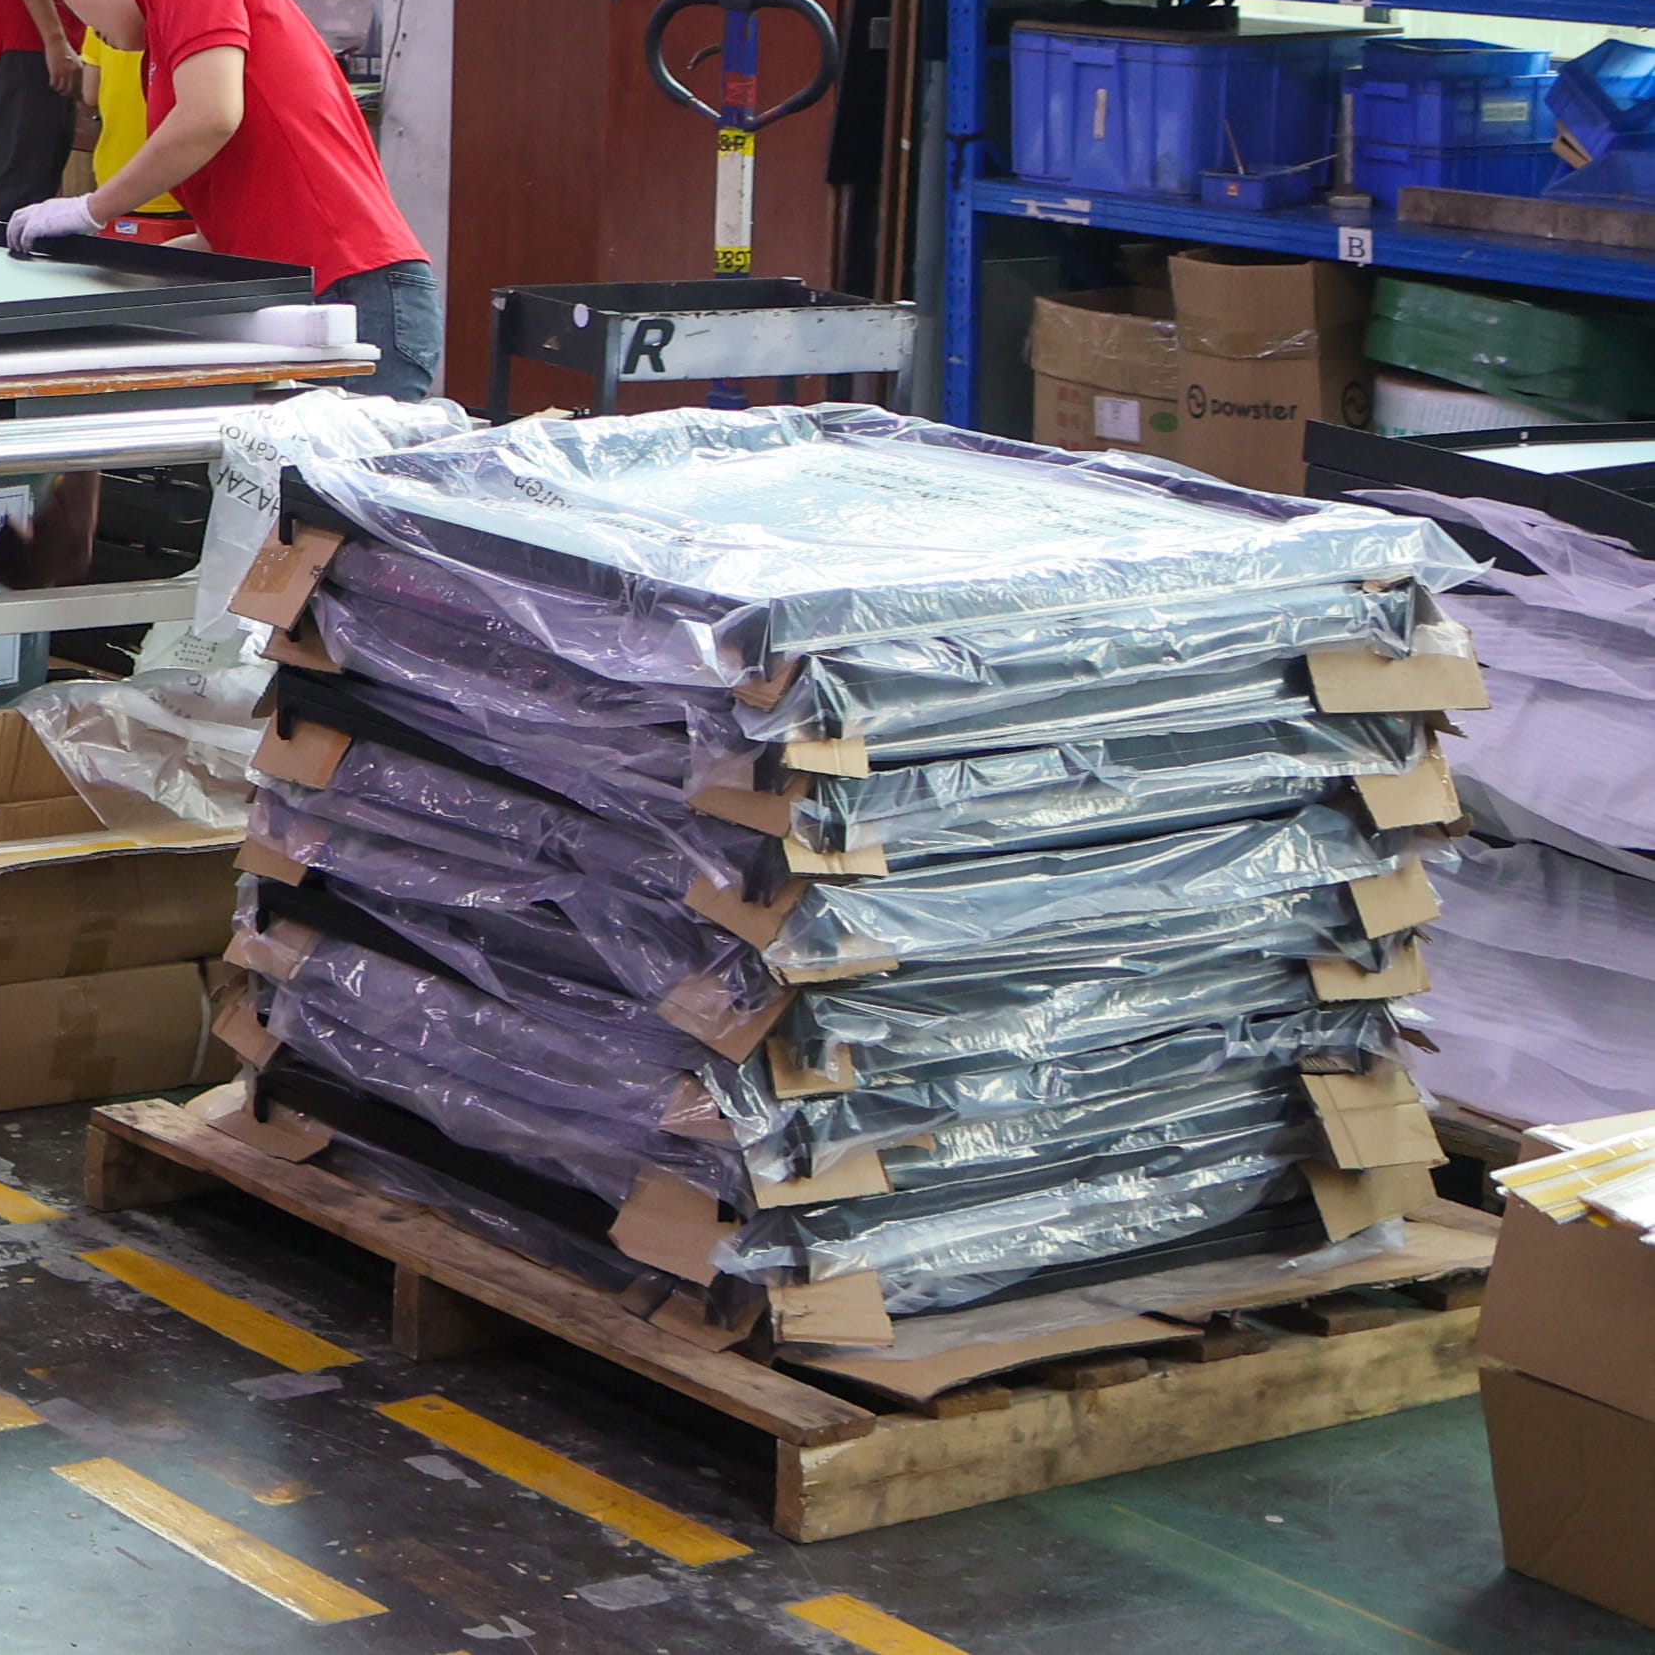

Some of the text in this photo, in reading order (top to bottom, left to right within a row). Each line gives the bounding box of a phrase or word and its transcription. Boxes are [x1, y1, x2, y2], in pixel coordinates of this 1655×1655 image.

[1347, 236, 1366, 258] B
[622, 318, 674, 375] R
[1210, 398, 1298, 421] powster
